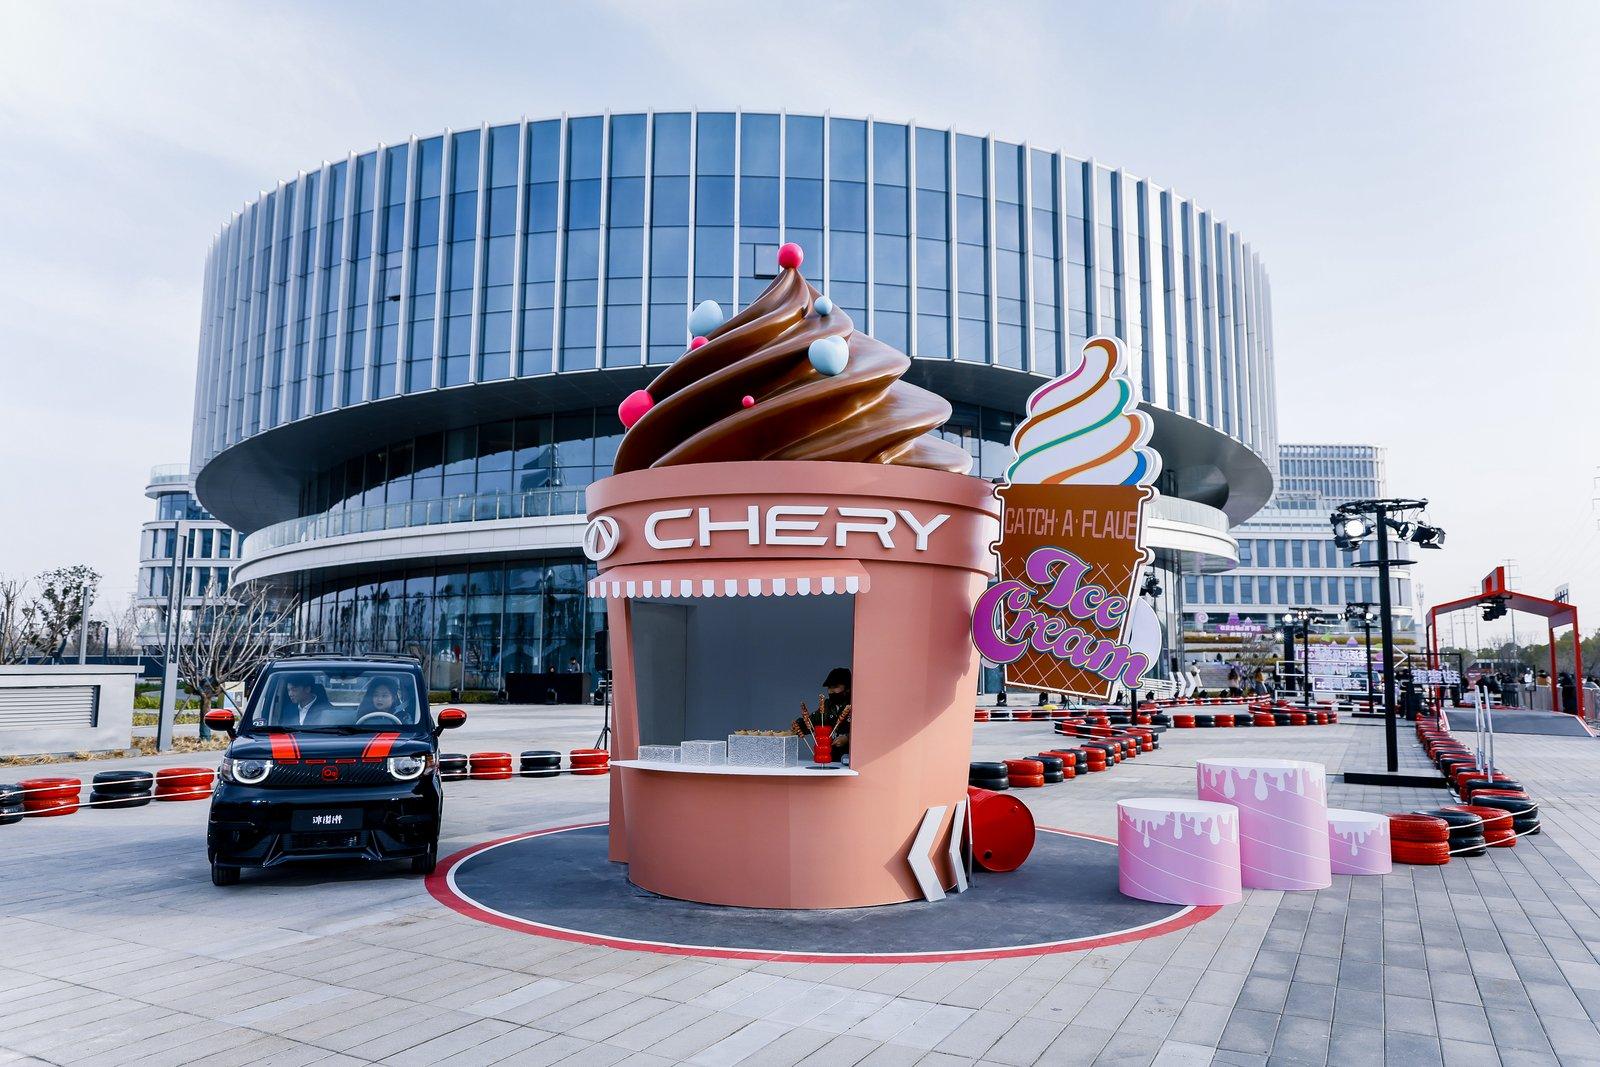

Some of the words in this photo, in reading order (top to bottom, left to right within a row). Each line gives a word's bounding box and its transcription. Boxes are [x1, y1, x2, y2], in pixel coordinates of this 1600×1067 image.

[644, 505, 951, 551] CHERY
[1026, 547, 1128, 629] Ice
[971, 580, 1149, 689] Cream
